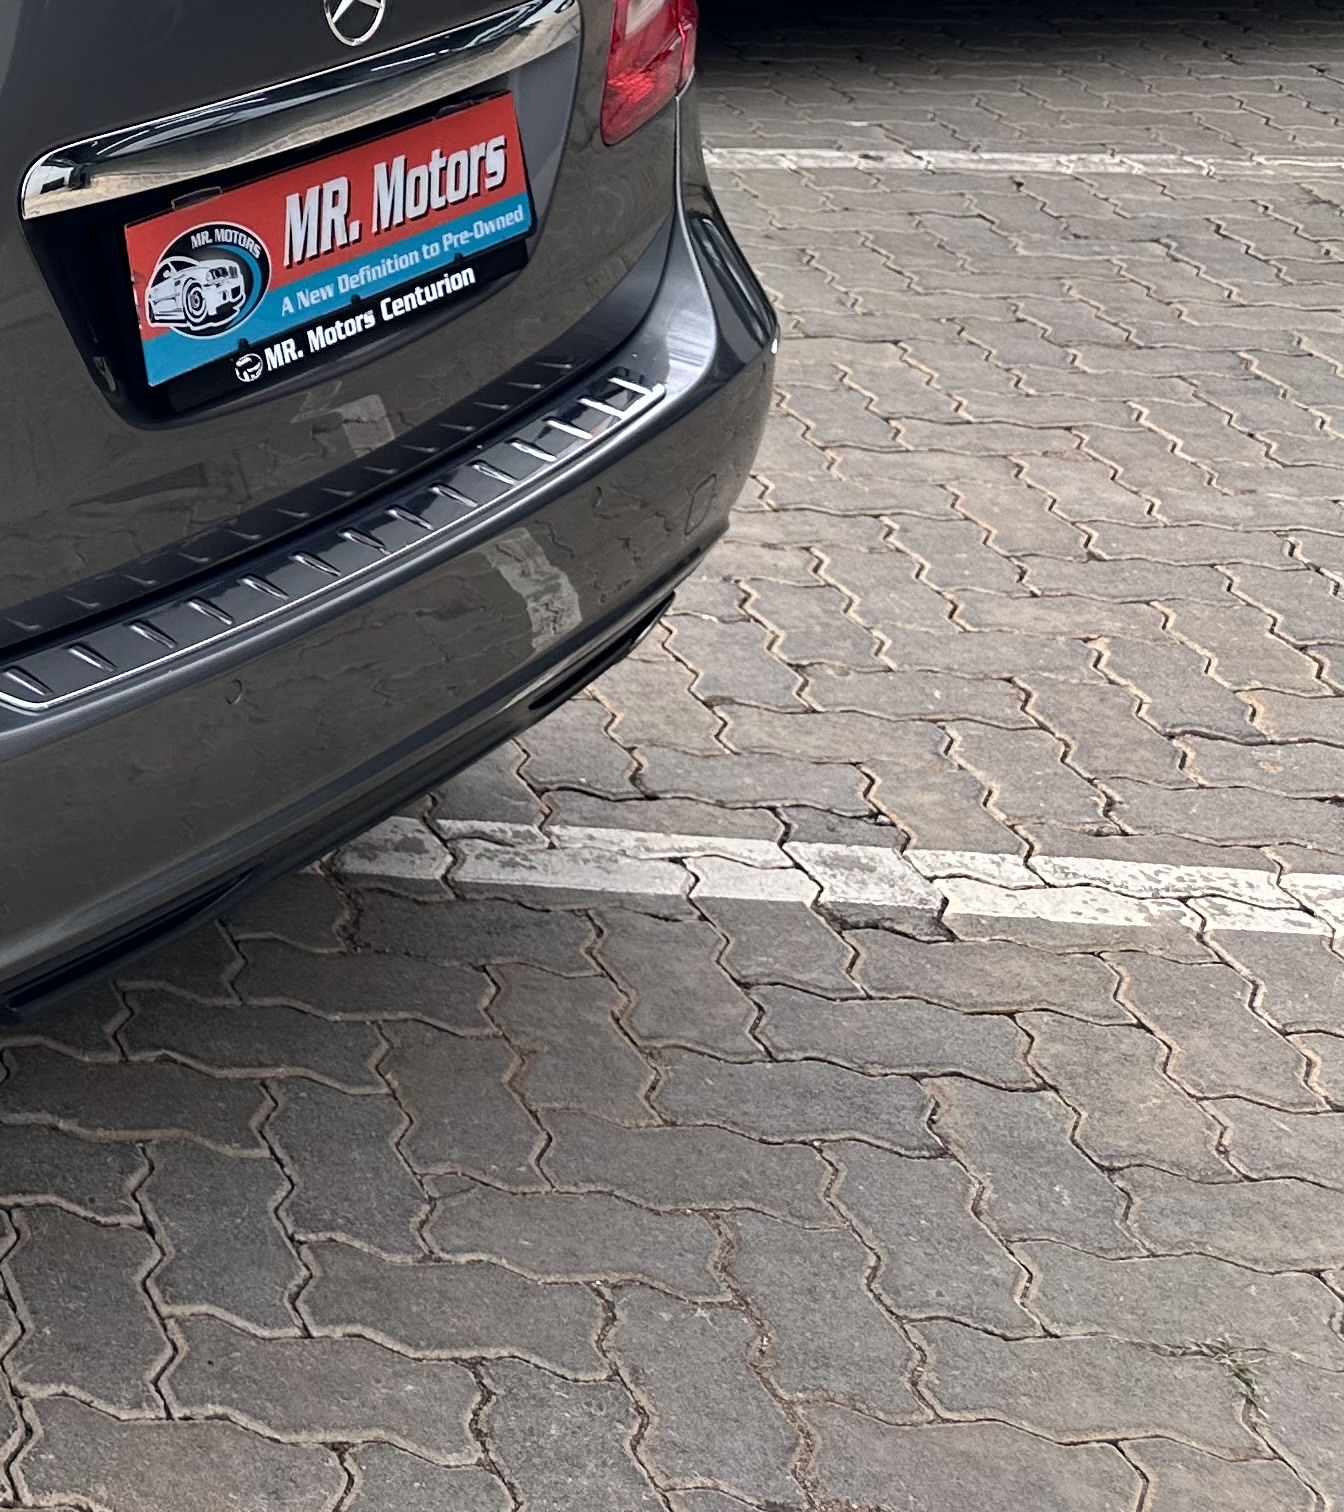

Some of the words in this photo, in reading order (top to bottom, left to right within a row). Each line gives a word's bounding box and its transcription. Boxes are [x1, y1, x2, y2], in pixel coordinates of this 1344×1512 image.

[190, 230, 213, 250] MR.
[214, 228, 261, 259] MOTORS
[283, 176, 361, 268] MR.
[372, 134, 506, 235] Motors
[281, 295, 295, 317] A
[297, 282, 334, 311] New
[337, 249, 420, 294] Definition
[422, 241, 440, 259] to
[442, 204, 524, 253] Pre-Owned
[264, 338, 304, 371] MR.
[307, 309, 376, 353] Motors
[380, 267, 476, 321] Centurion
